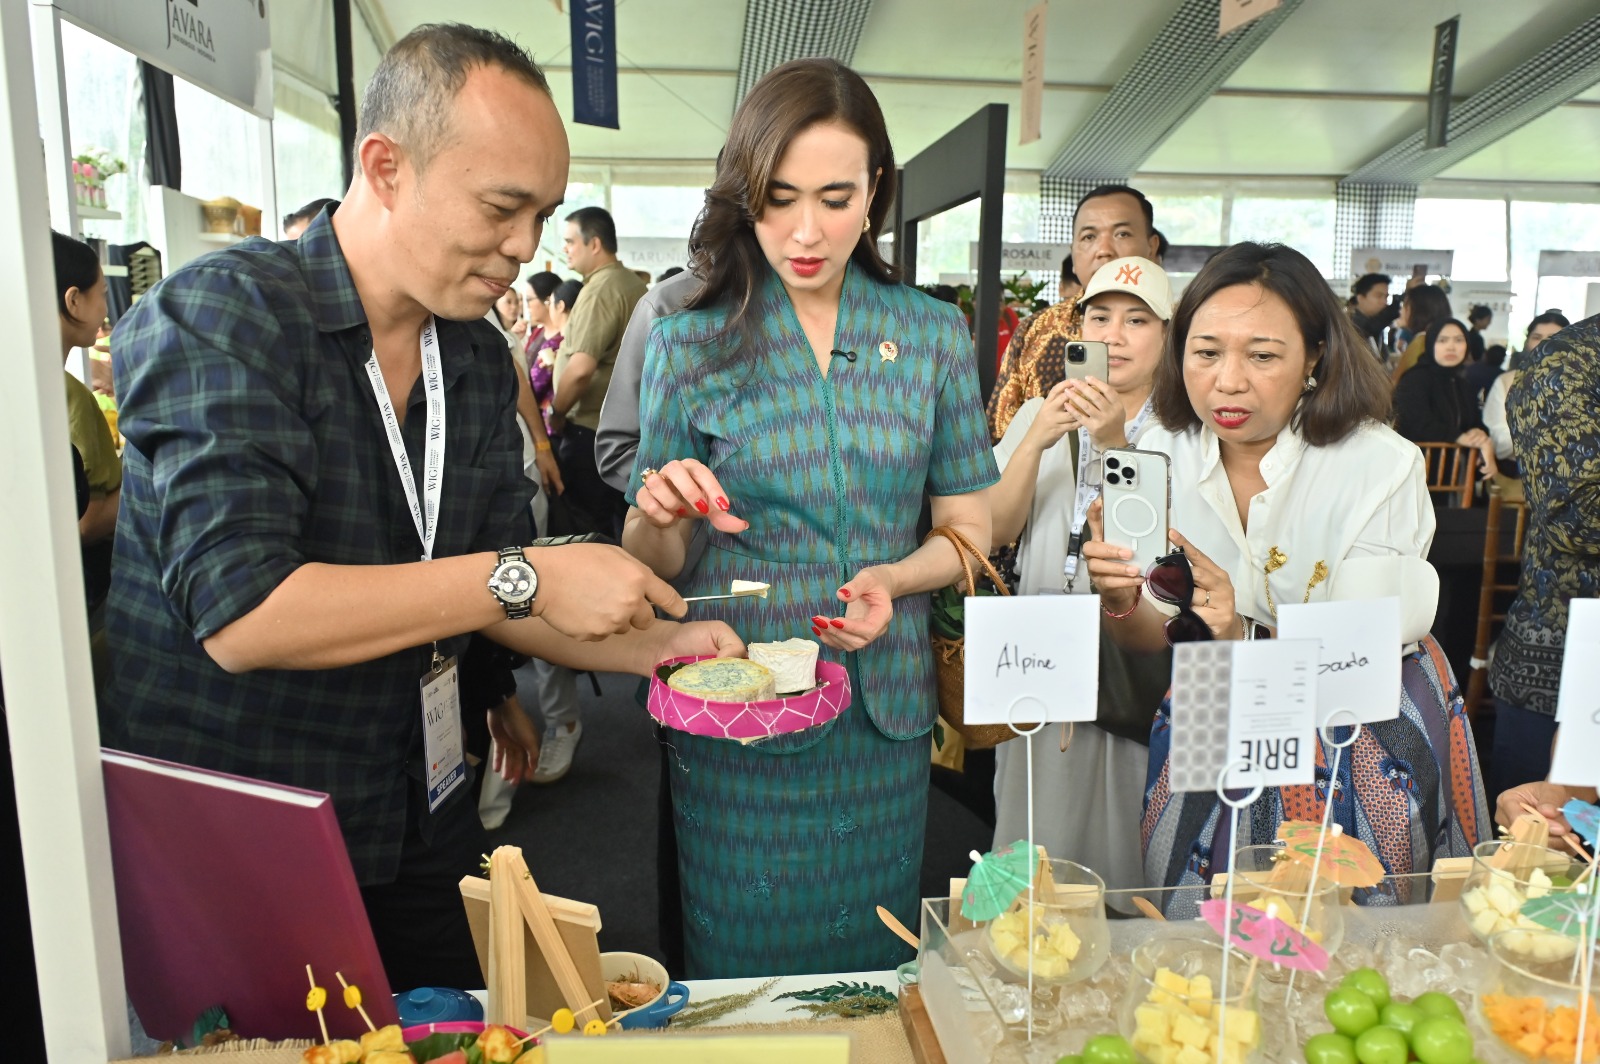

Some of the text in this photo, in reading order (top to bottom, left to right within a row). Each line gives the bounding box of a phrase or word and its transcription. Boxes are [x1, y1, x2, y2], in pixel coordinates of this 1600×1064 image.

[166, 0, 215, 53] JAVARA
[1002, 249, 1052, 260] ROSALIE
[428, 372, 439, 392] WIG
[383, 402, 395, 425] WIG
[431, 418, 441, 441] WIG
[399, 453, 408, 475] WIG
[428, 469, 438, 492] WIG
[995, 643, 1056, 678] Alpine
[1239, 737, 1300, 773] BRIE
